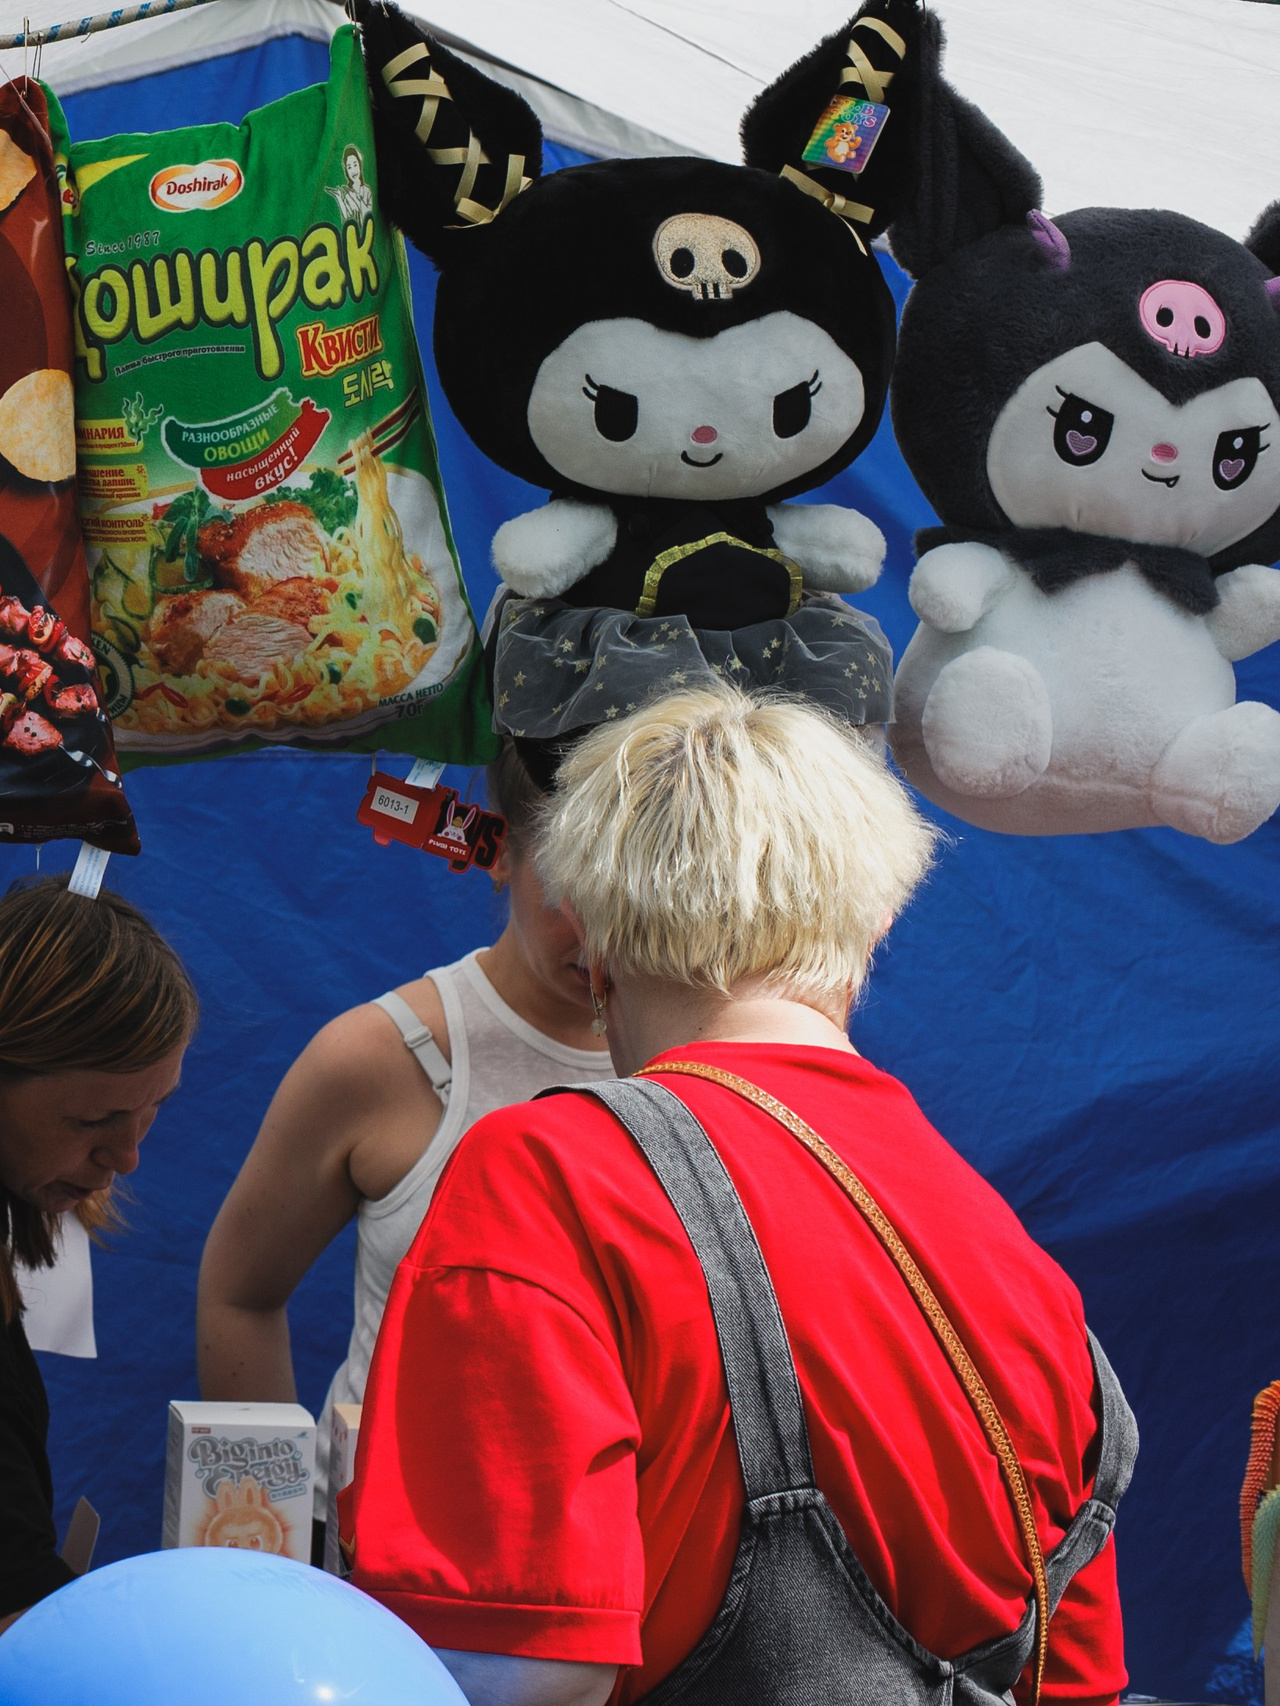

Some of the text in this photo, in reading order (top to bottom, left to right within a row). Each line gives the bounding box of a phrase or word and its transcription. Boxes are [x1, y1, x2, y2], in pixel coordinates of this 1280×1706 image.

[831, 108, 877, 127] TOYS
[166, 168, 229, 197] Doshirak
[85, 230, 160, 256] Since 1987
[342, 359, 394, 407] 도시락
[182, 403, 280, 443] РАЗНООБРАЗНЫЕ
[204, 428, 270, 462] ОВОЩИ
[226, 426, 300, 482] насыщенный
[254, 446, 298, 490] вкус!
[379, 682, 444, 707] МАССА НЕТТО
[378, 794, 409, 814] 6013-1
[190, 1438, 249, 1471] Big
